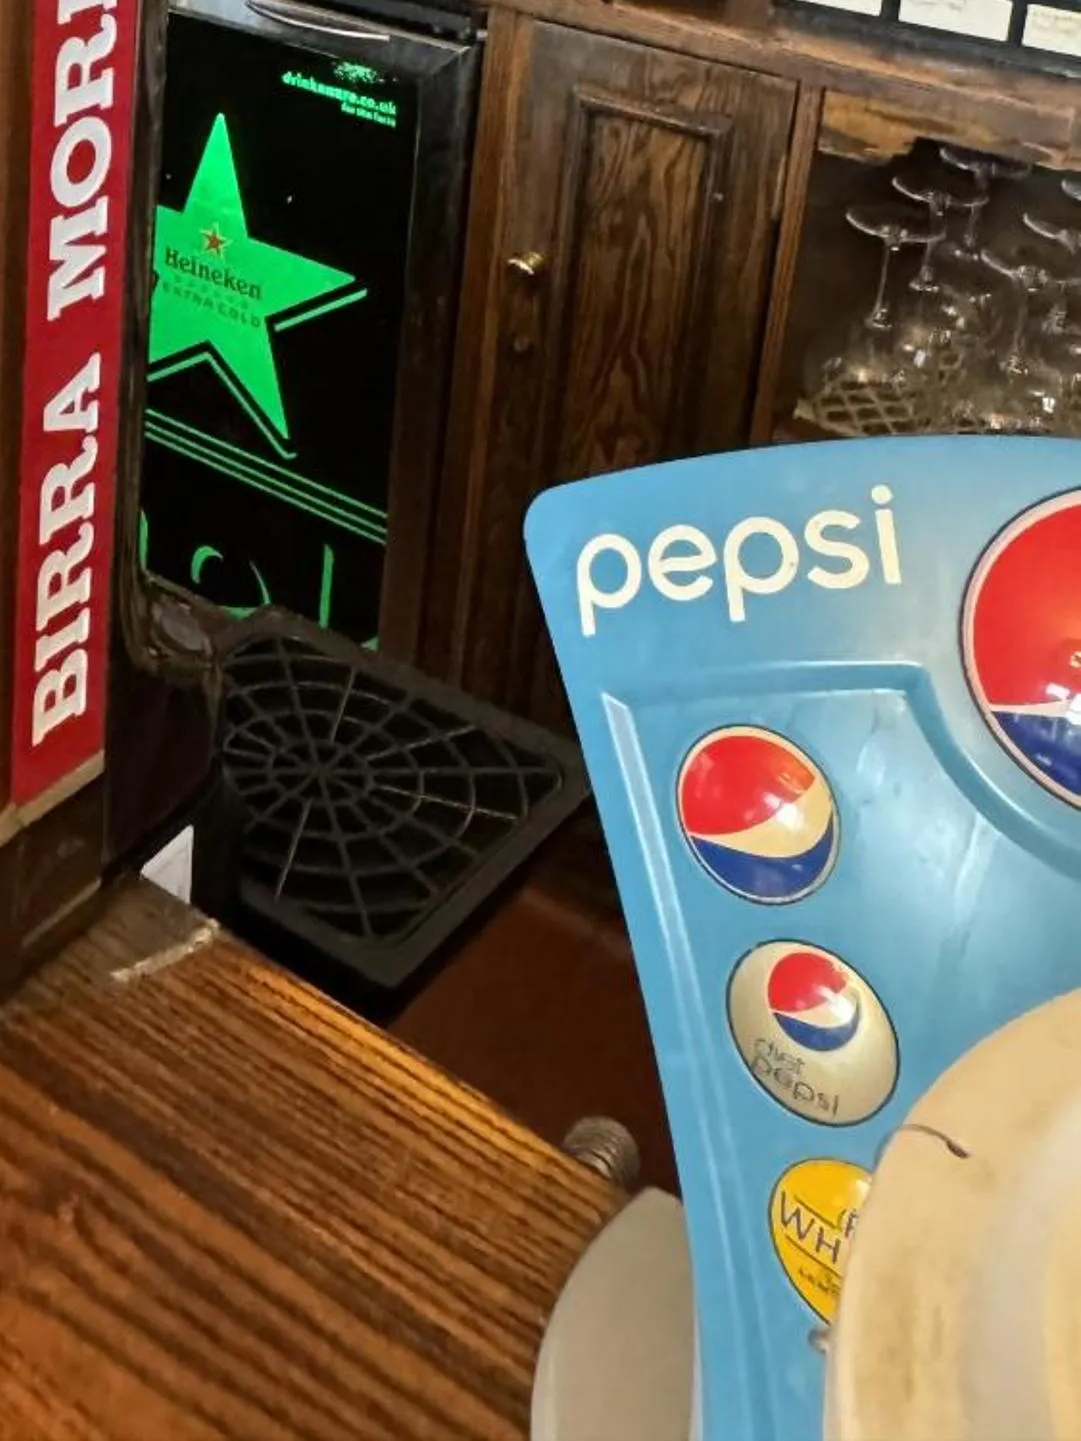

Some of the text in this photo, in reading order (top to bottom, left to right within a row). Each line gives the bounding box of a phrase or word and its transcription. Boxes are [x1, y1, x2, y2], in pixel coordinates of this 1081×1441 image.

[165, 246, 262, 301] Heineken
[32, 351, 102, 747] BIRRA
[576, 483, 902, 638] pepsi
[751, 1055, 839, 1116] pepsi
